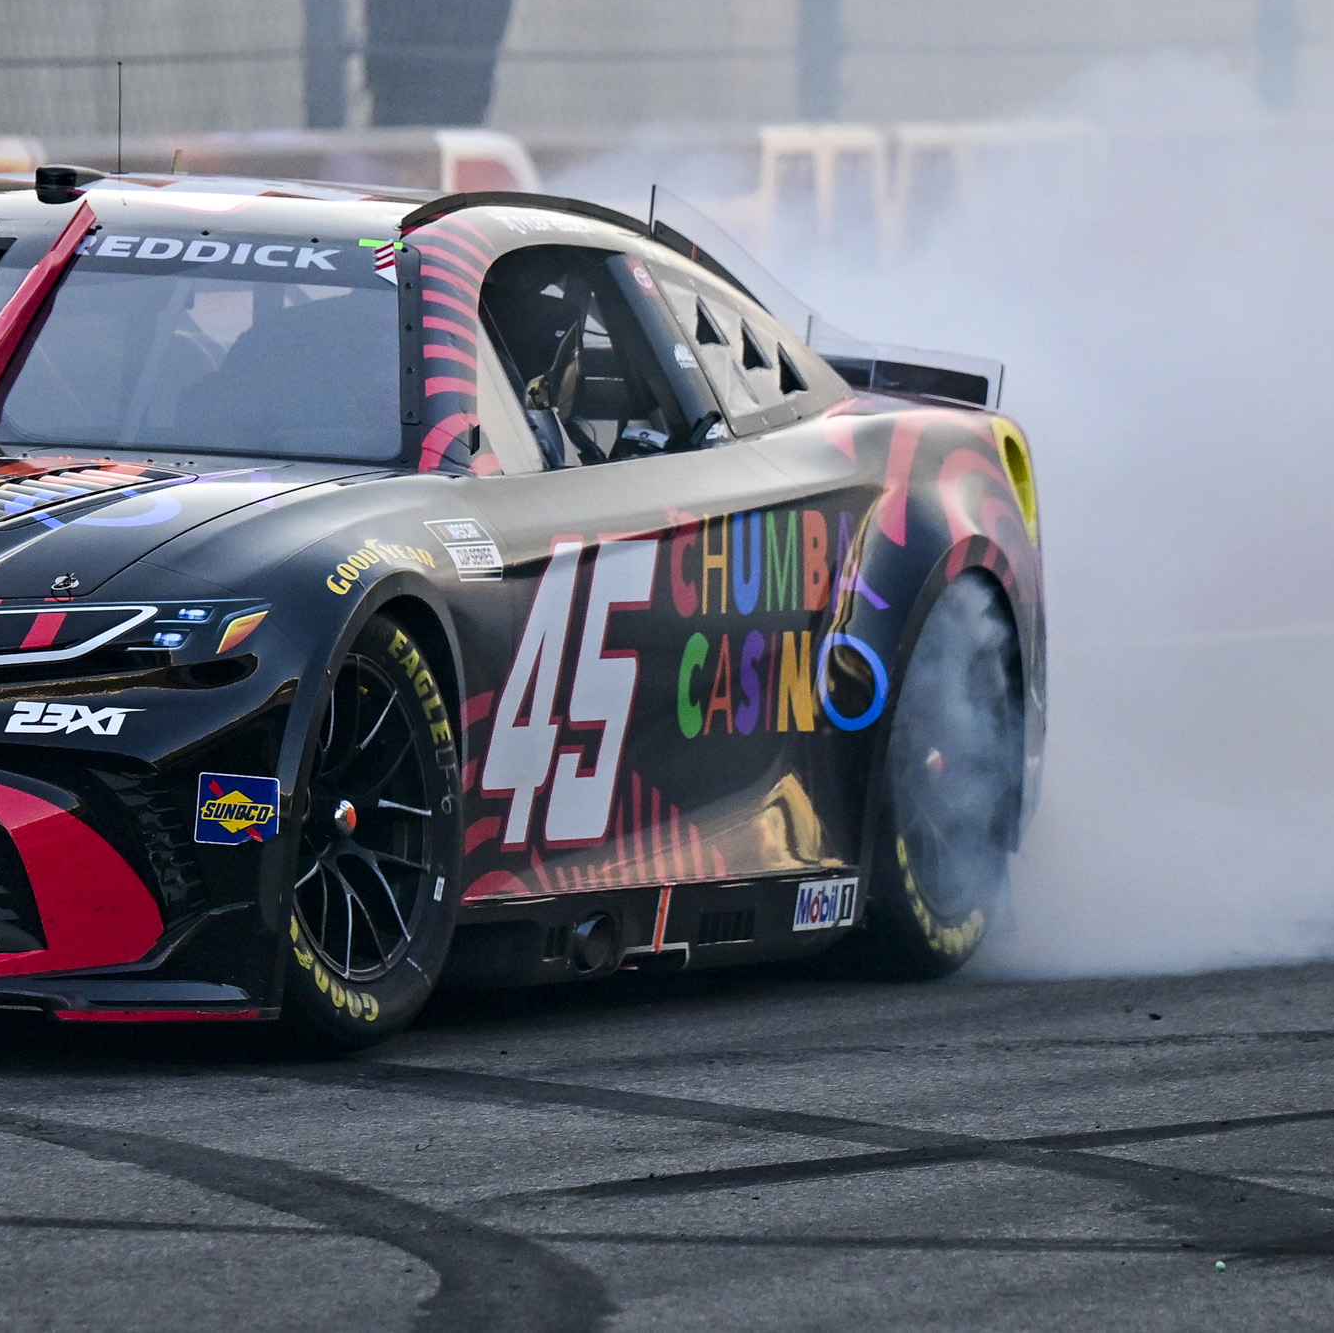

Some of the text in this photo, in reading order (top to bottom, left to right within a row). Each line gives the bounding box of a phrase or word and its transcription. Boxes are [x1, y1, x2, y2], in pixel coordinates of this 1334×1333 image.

[327, 539, 436, 595] GOODYEAR
[669, 509, 890, 618] CHUMBA
[4, 701, 147, 735] 23XI
[389, 629, 451, 744] EAGLE
[480, 533, 662, 851] 45
[677, 630, 889, 739] CASINO
[203, 802, 270, 822] SUNOCO
[796, 886, 839, 924] Mobil
